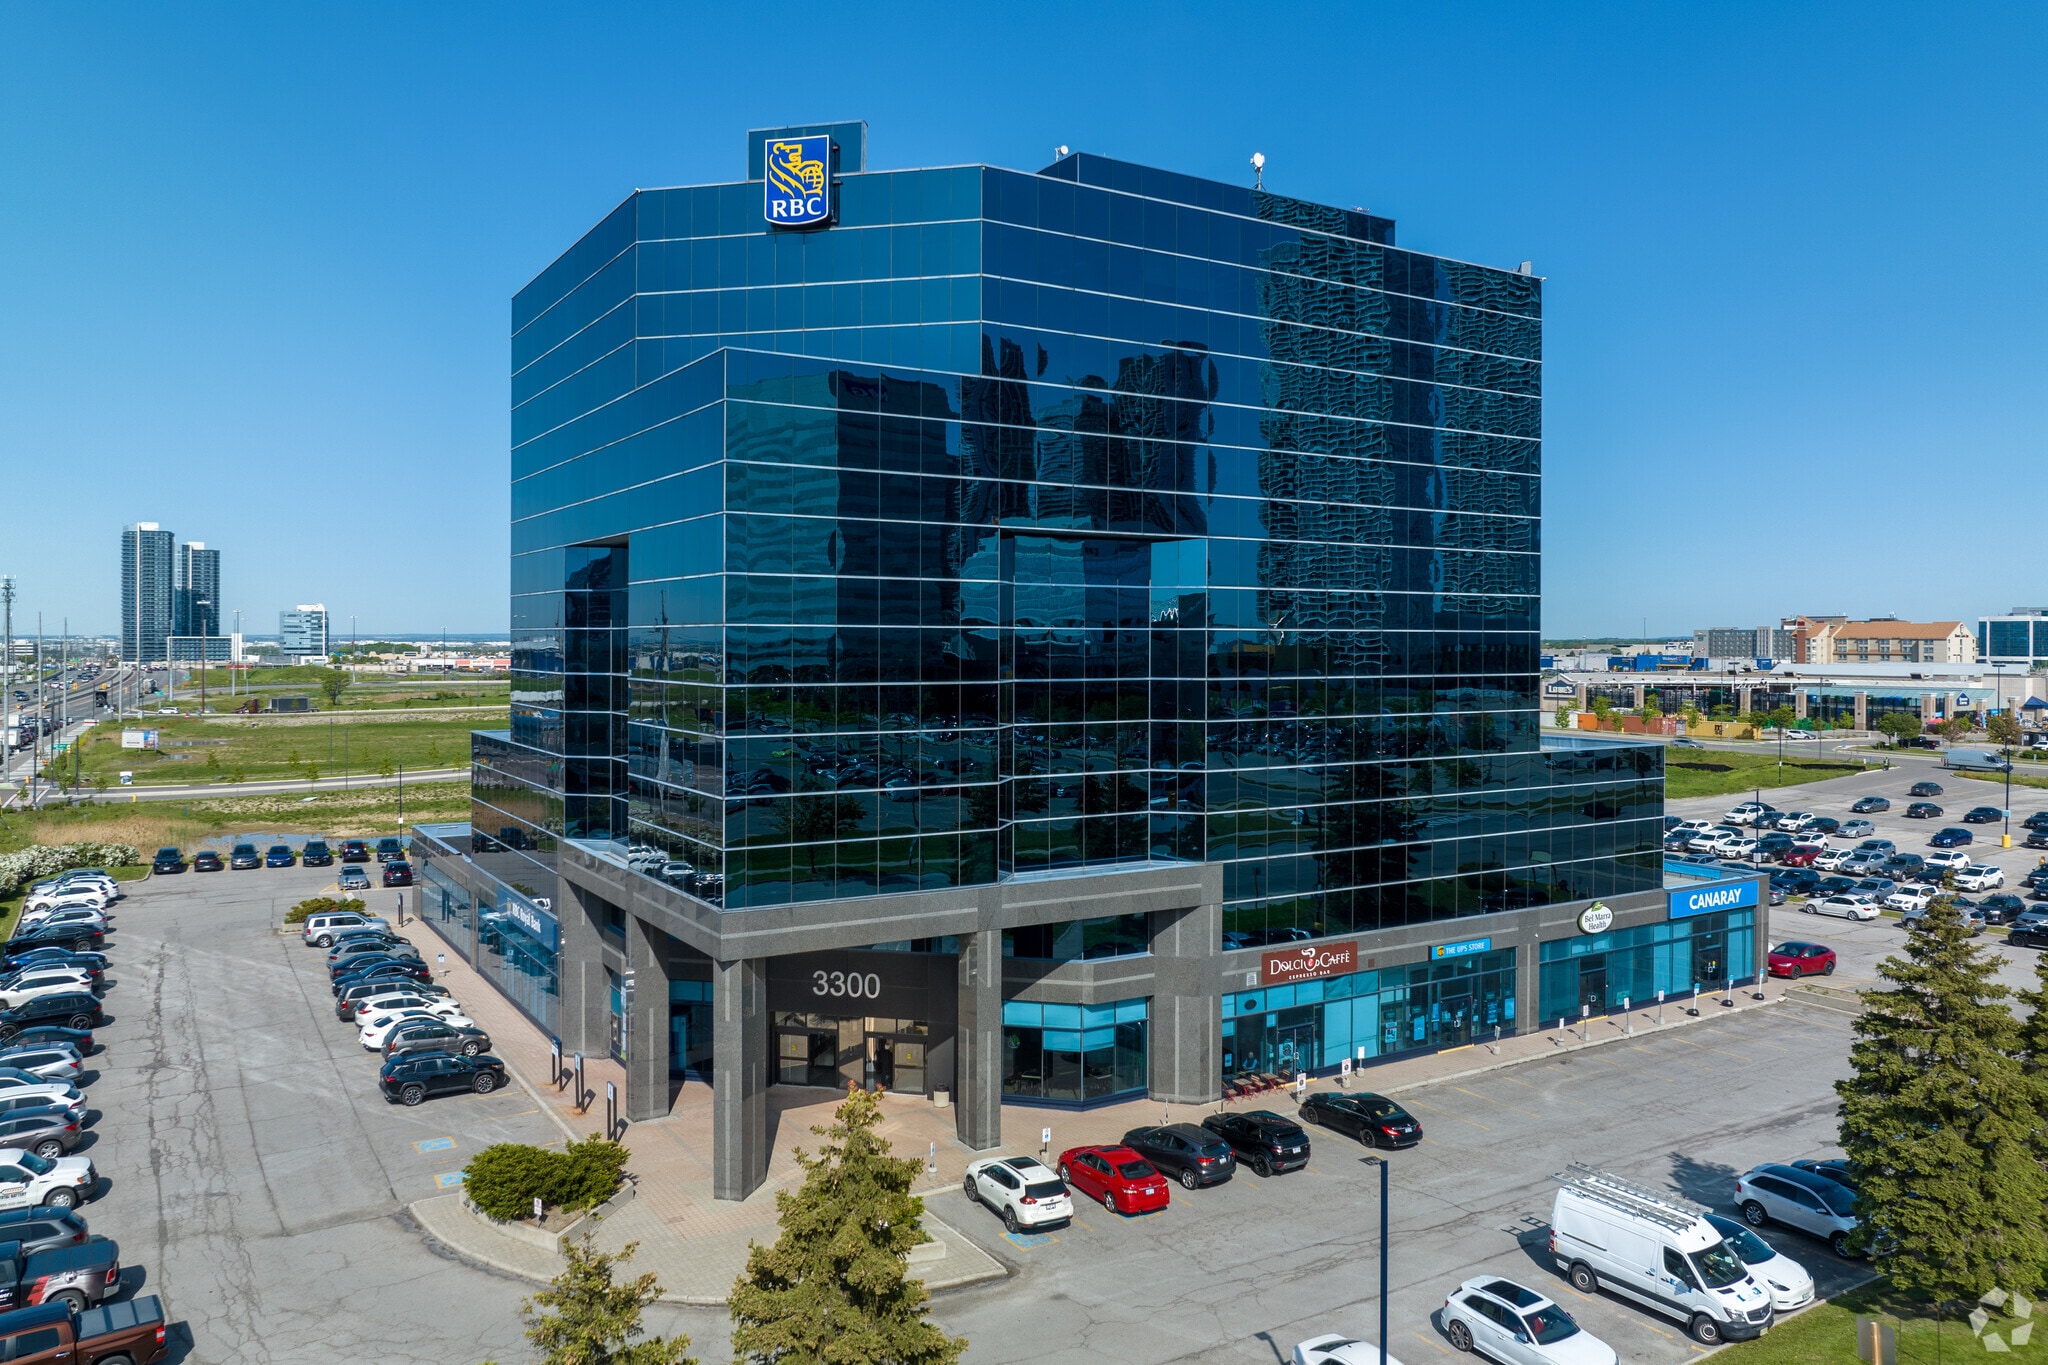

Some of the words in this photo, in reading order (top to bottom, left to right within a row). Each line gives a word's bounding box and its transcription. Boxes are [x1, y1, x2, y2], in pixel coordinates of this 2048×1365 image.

[772, 197, 821, 218] RBC
[1689, 888, 1742, 910] CANARAY
[520, 907, 531, 927] Royal
[531, 915, 541, 934] Bank
[1584, 914, 1594, 923] Bel
[1595, 912, 1611, 922] Marra
[1588, 920, 1607, 931] Health
[1445, 947, 1456, 955] THE
[1456, 944, 1468, 953] UPS
[1468, 941, 1485, 951] STORE
[1270, 958, 1303, 975] DOLCI
[1288, 971, 1317, 980] ESPRESSO
[812, 970, 881, 999] 3300
